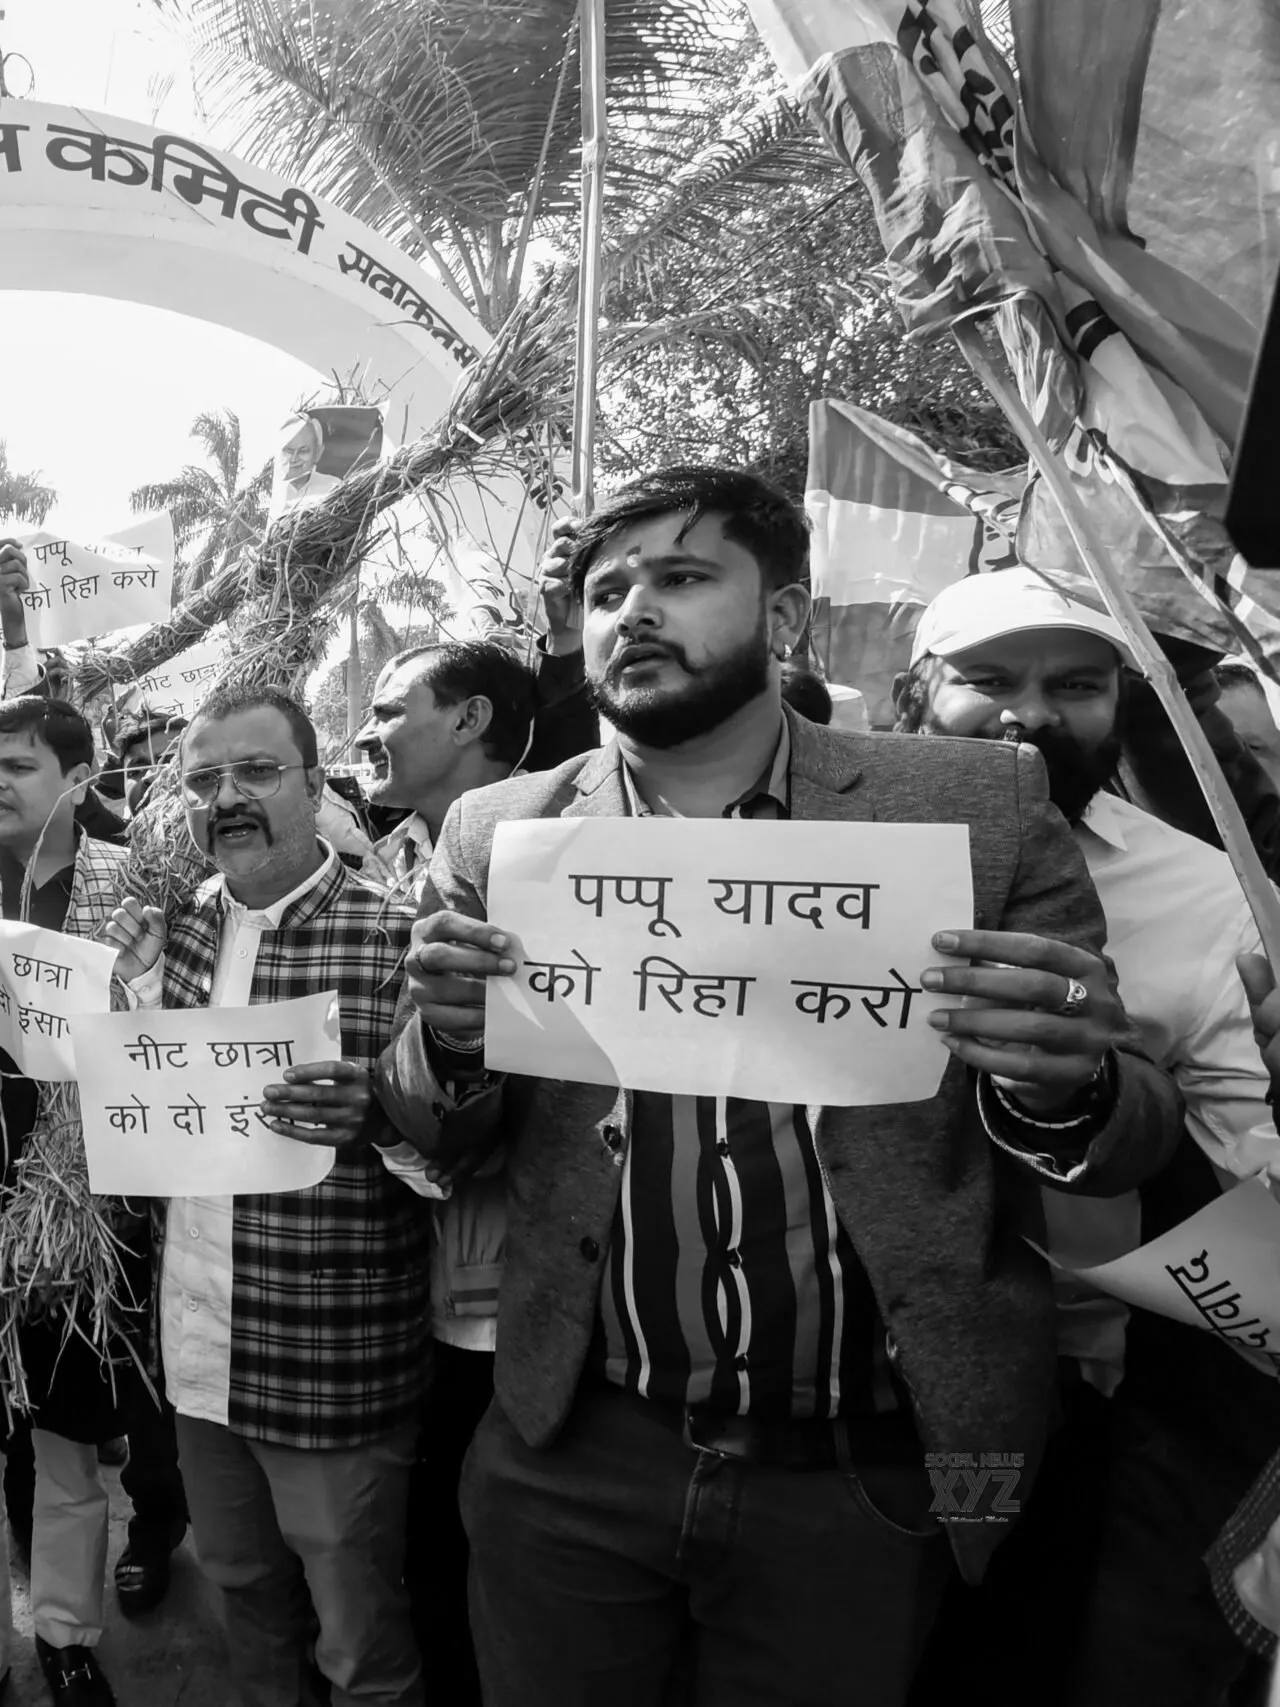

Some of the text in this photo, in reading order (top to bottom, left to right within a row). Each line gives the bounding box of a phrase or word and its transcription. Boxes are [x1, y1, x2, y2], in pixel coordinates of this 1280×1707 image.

[45, 123, 325, 255] कमिटी
[33, 540, 72, 566] पप्पू
[22, 564, 159, 611] को रिहा करो
[568, 874, 880, 938] पप्पू यादव
[12, 953, 73, 990] छात्रा
[523, 948, 923, 1029] को रिहा करो
[124, 1034, 295, 1070] नीट छात्रा
[105, 1093, 150, 1134] को
[168, 1093, 207, 1135] दो
